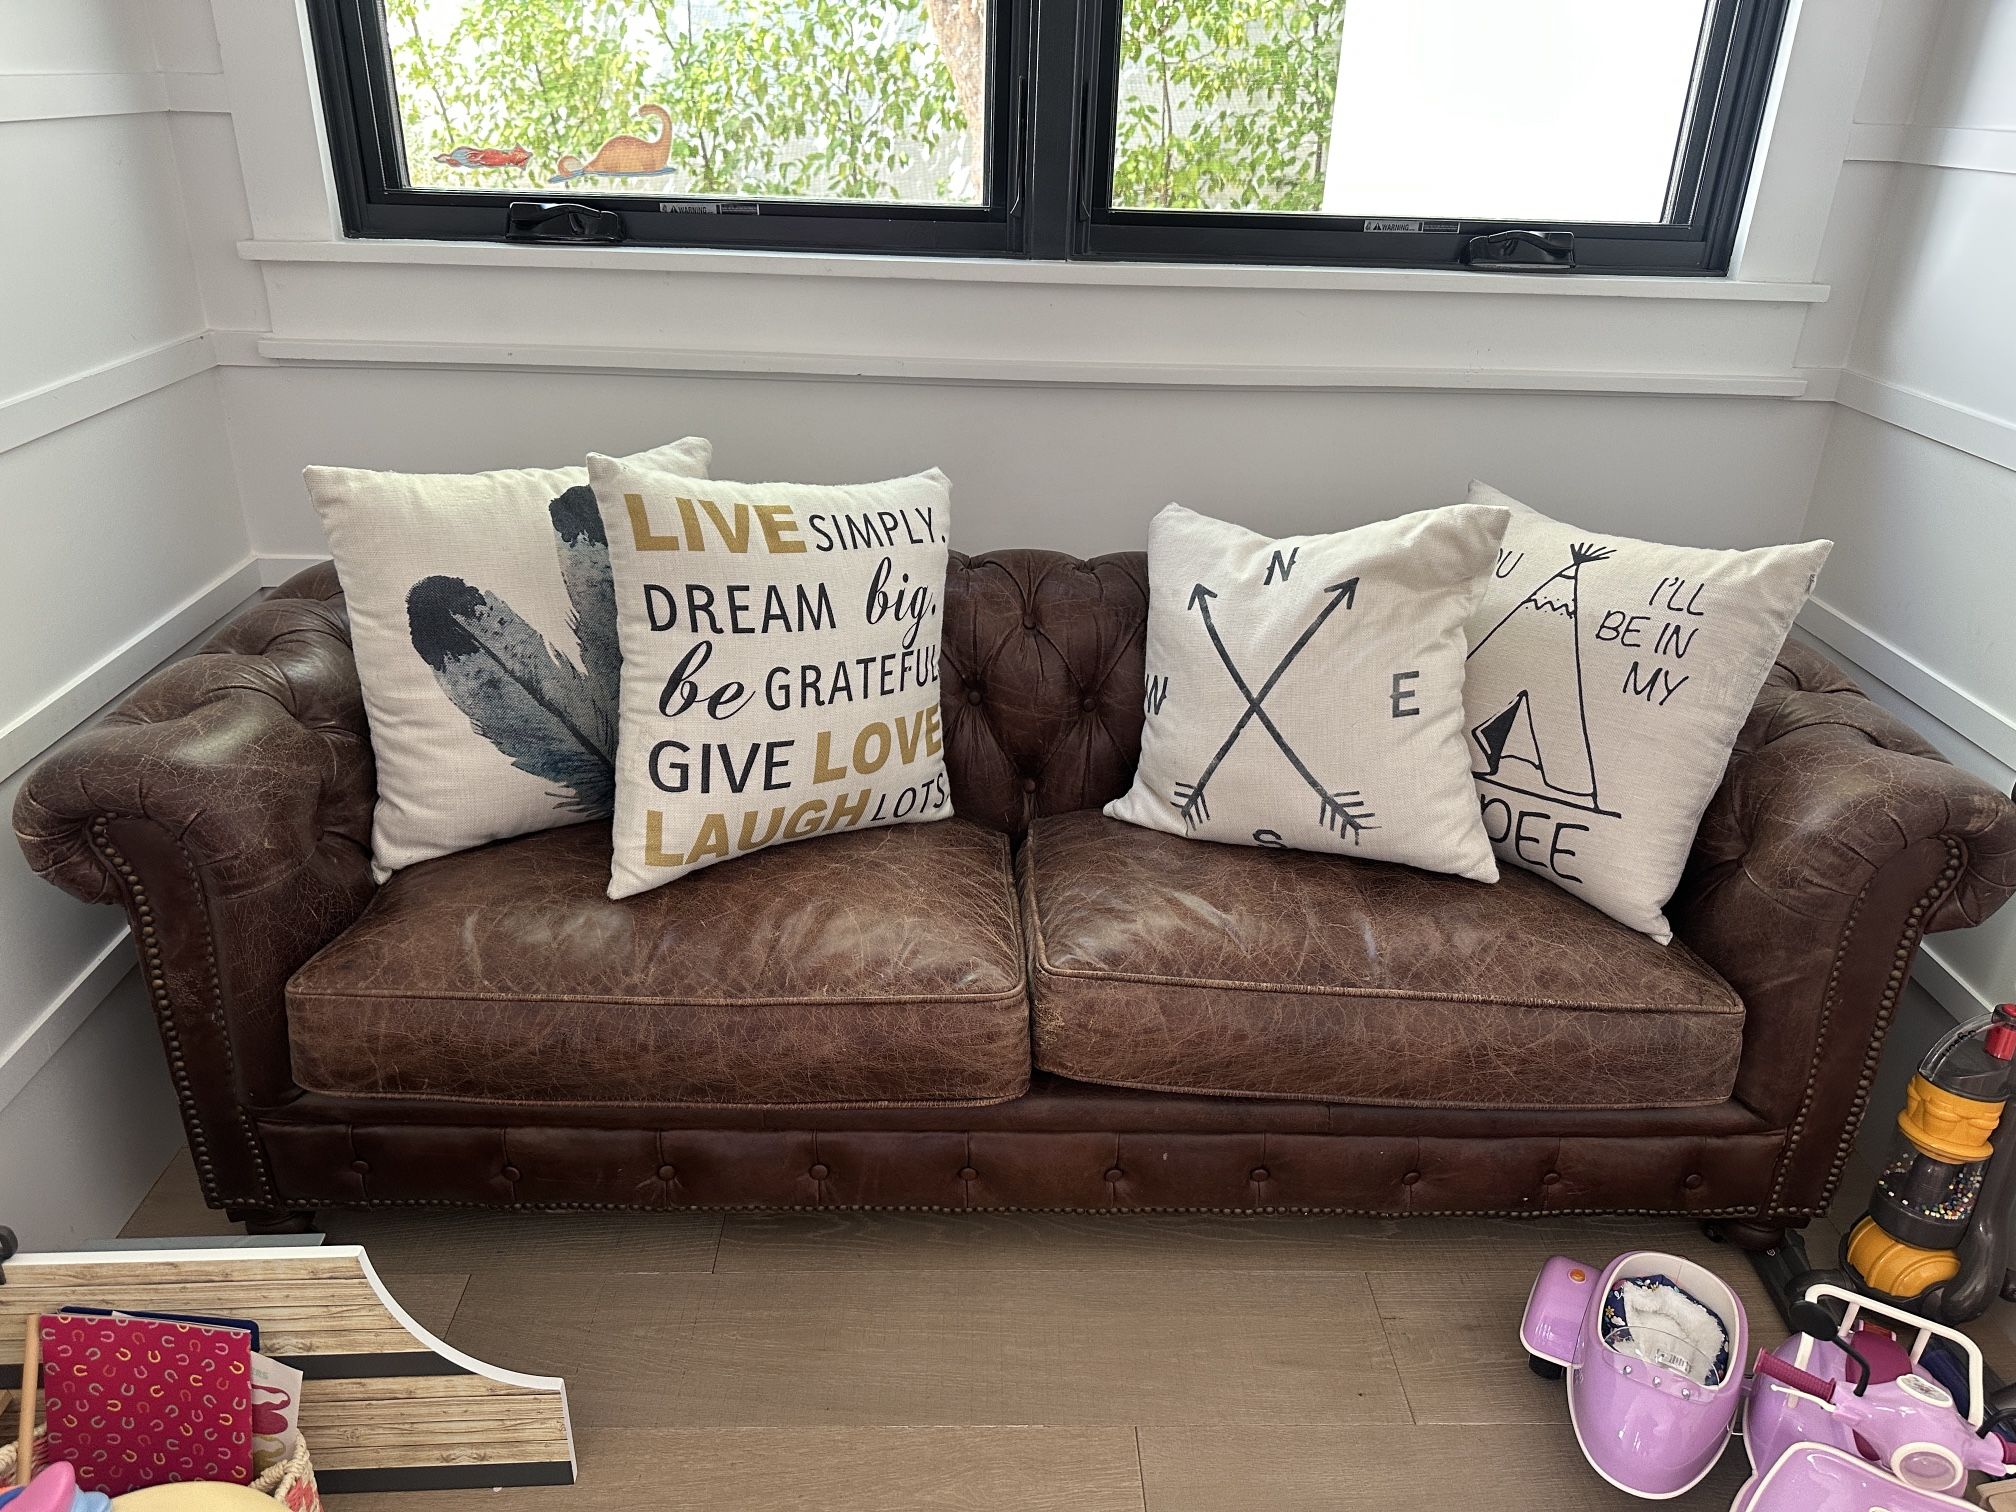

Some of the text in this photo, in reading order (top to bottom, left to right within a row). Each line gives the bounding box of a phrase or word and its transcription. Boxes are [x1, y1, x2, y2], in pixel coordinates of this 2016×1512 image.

[1382, 223, 1409, 232] WARNING
[624, 493, 946, 554] LIVE SIMPLY.
[1263, 546, 1300, 586] N
[643, 556, 937, 650] DREAM big.
[1648, 577, 1704, 616] I'LL
[1595, 609, 1700, 659] BE IN
[658, 640, 939, 720] be GRATEFUL
[1389, 670, 1420, 718] E
[1622, 661, 1690, 706] MY
[648, 703, 943, 794] GIVE LOVE
[644, 788, 872, 868] LAUGH
